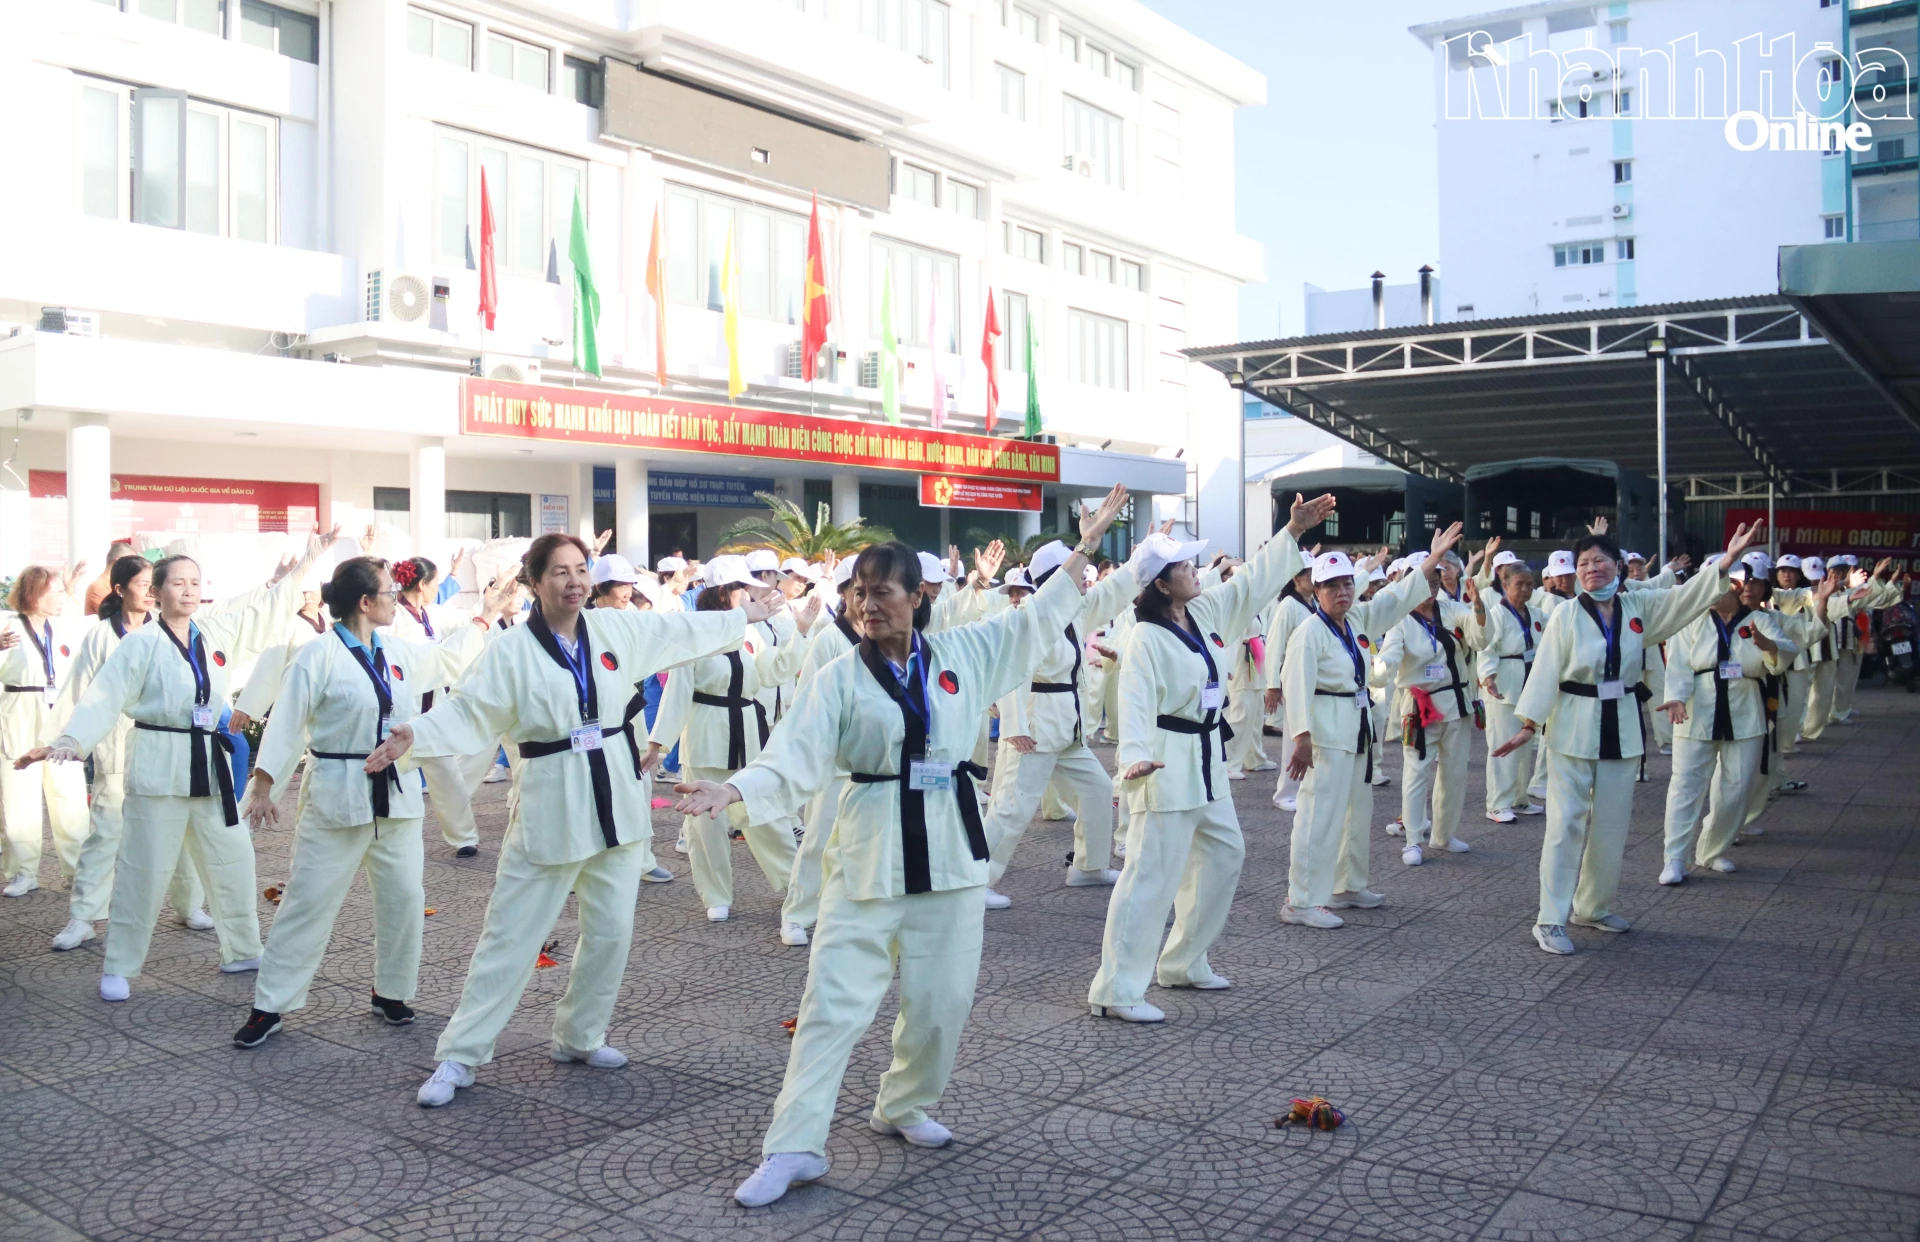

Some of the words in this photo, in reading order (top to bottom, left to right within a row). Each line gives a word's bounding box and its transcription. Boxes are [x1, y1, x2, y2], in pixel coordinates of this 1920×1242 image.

[474, 391, 503, 423] PHÁT
[505, 398, 528, 425] HUY
[530, 396, 552, 428] SỨC
[554, 403, 585, 435] MẠNH
[587, 399, 612, 433] KHỐI
[614, 409, 632, 440] ĐẠI
[633, 407, 660, 437] ĐOÀN
[661, 407, 680, 439] KẾT
[681, 411, 700, 441] DÂN
[742, 422, 767, 451] MẠNH
[768, 422, 790, 449] TOÀN
[791, 424, 810, 455] DIỆN
[811, 426, 832, 453] CÔNG
[834, 429, 854, 460] CUỘC
[892, 435, 906, 460] DÂN
[1041, 455, 1056, 474] MINH
[1795, 527, 1842, 545] MINH
[1848, 529, 1907, 548] GROUP
